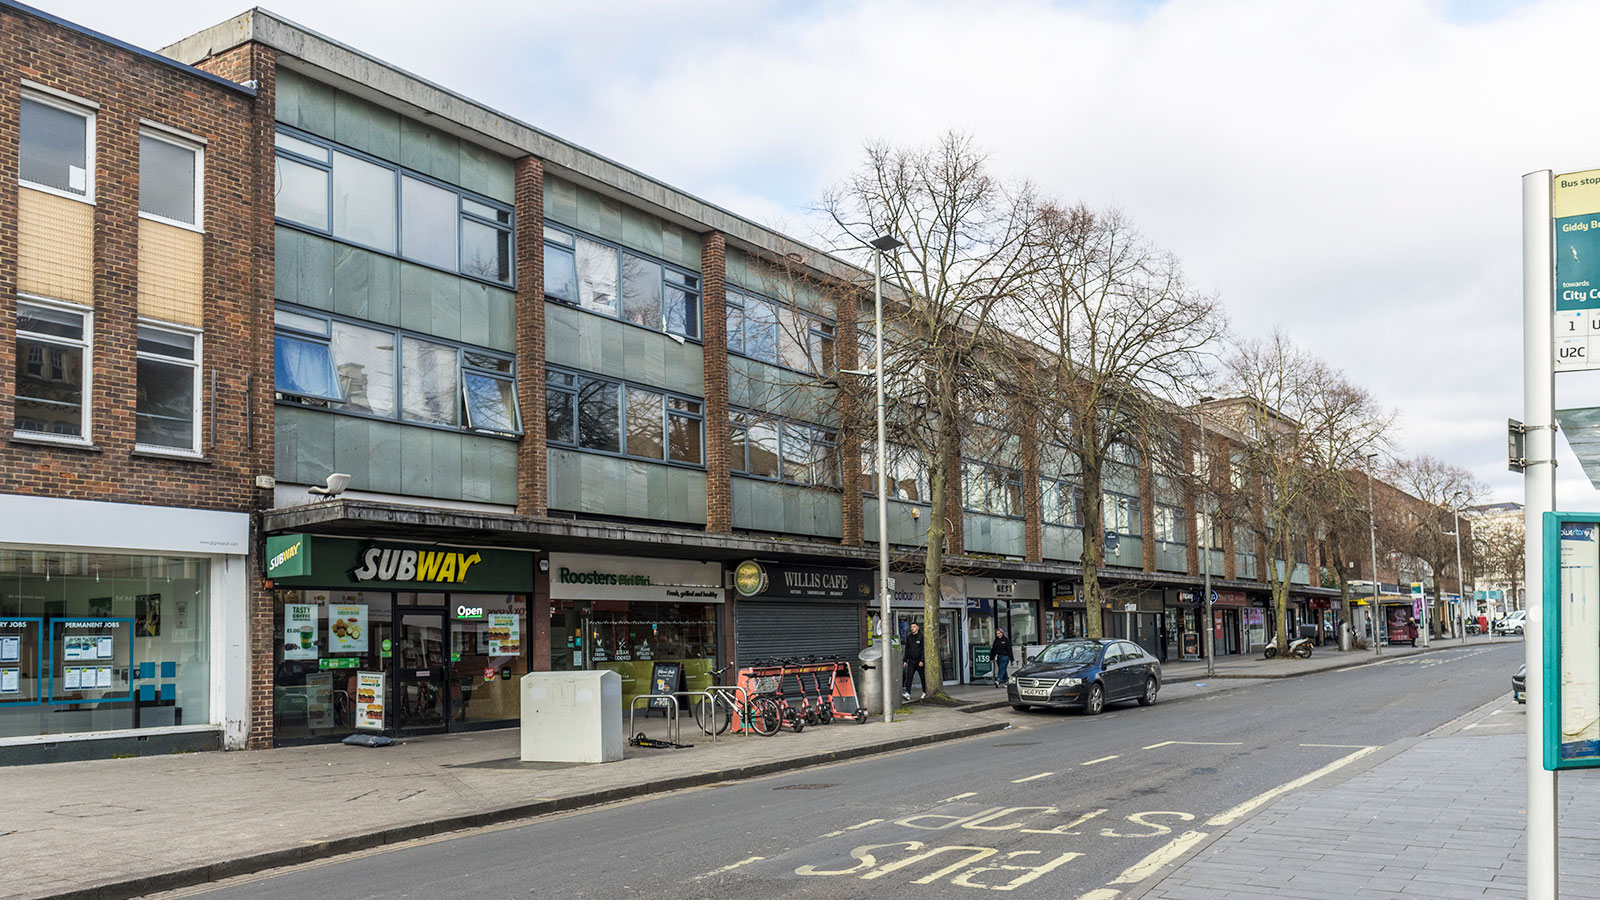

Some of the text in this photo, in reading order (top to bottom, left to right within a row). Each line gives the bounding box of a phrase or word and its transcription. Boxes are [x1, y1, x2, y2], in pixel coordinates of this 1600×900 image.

[1561, 176, 1600, 188] Bus stop
[1562, 222, 1589, 232] Giddy
[1562, 280, 1590, 288] towards
[1562, 291, 1587, 301] City
[1569, 321, 1575, 331] 1
[1560, 347, 1585, 358] U2C
[269, 541, 301, 571] SUBWAY
[354, 548, 481, 582] SUBWAY
[560, 567, 617, 585] Roosters
[784, 572, 848, 589] WILLIS CAFE
[292, 606, 311, 614] TASTY
[457, 605, 483, 618] Open
